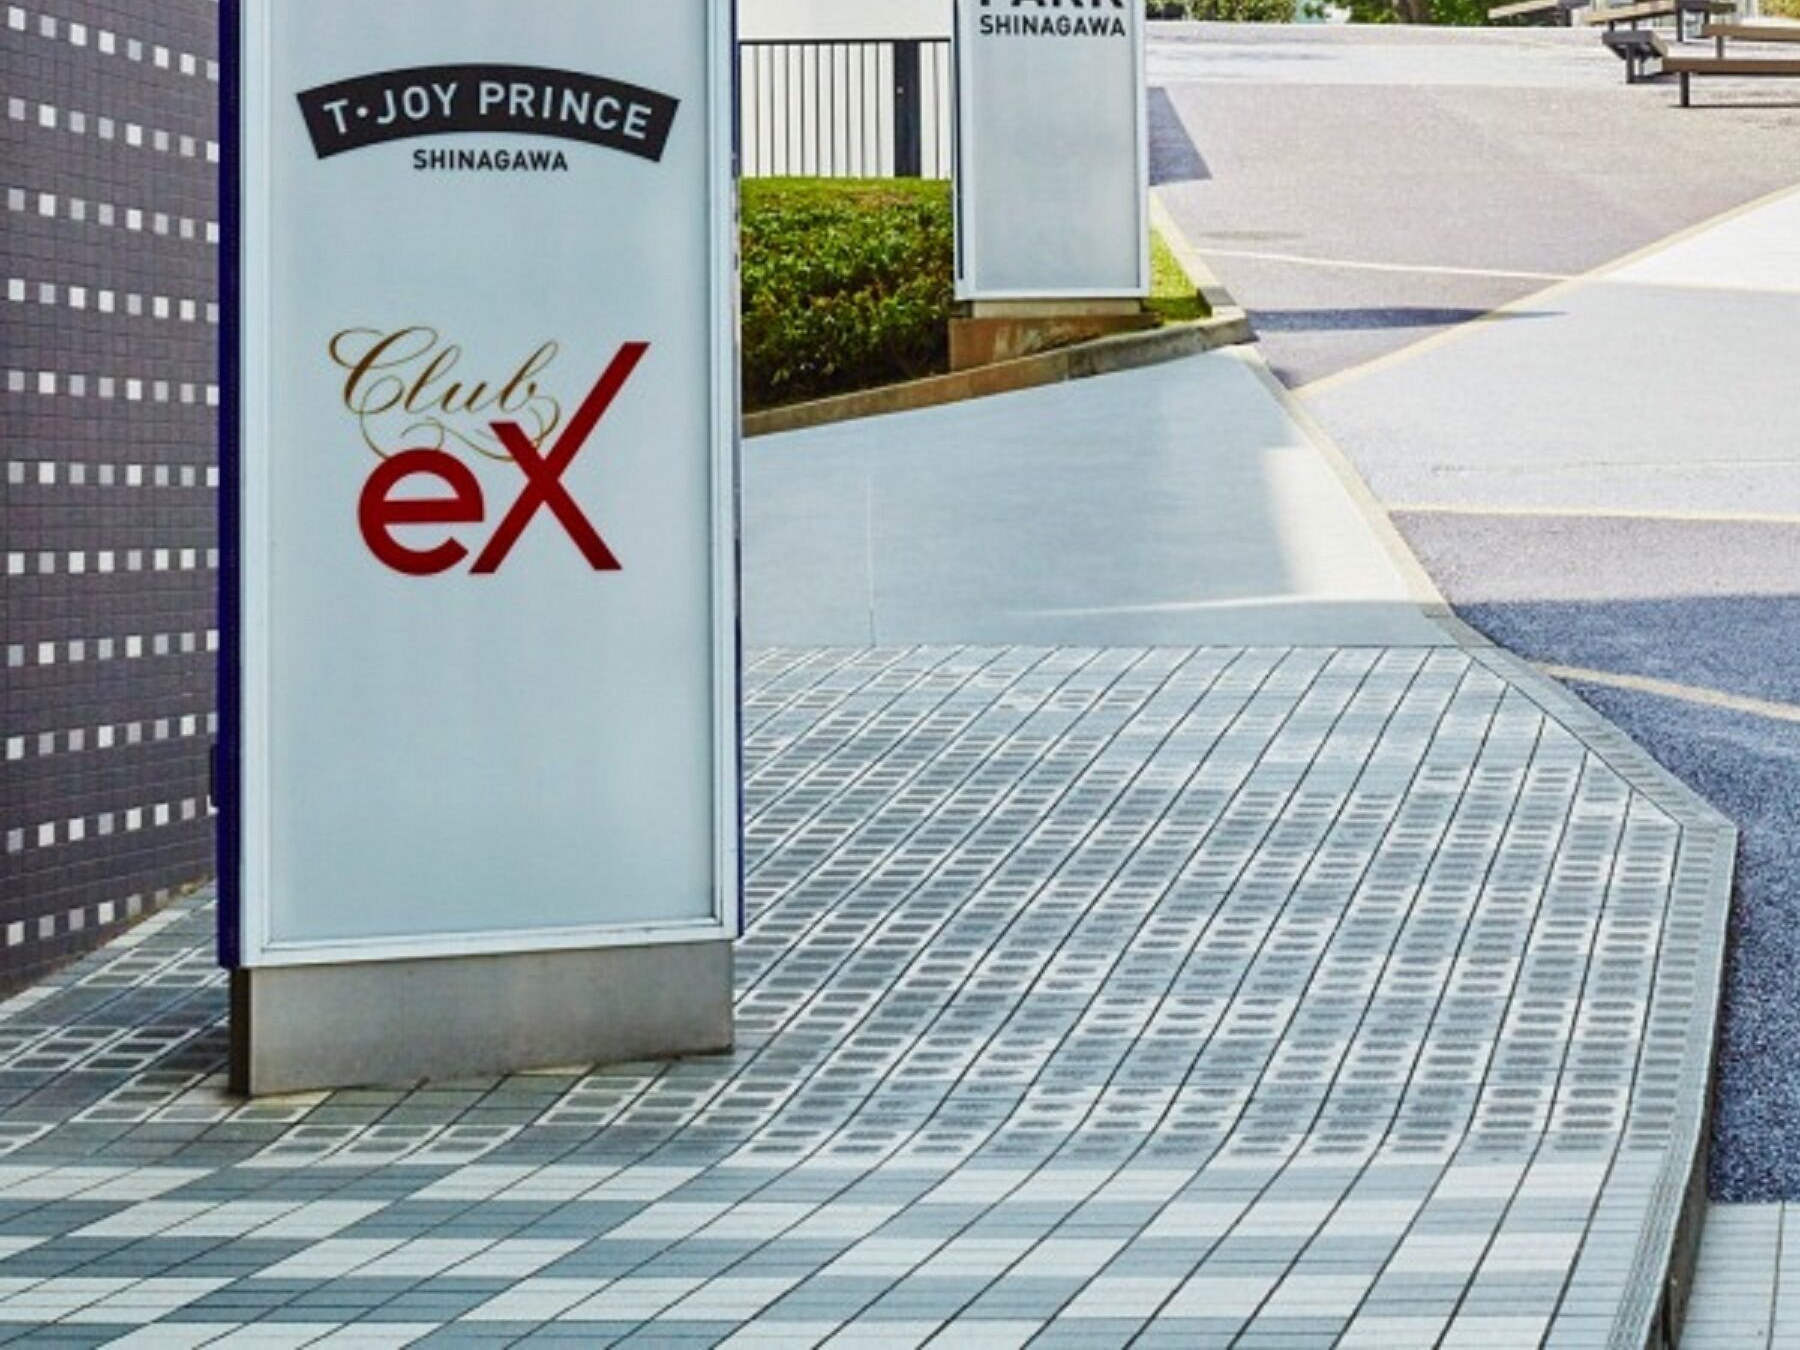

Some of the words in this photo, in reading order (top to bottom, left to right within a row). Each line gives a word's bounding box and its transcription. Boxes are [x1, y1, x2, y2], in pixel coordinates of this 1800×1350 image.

[979, 14, 1126, 38] SHINAGAWA
[477, 81, 652, 140] PRINCE
[413, 149, 569, 172] SHINAGAWA
[328, 326, 561, 460] Club
